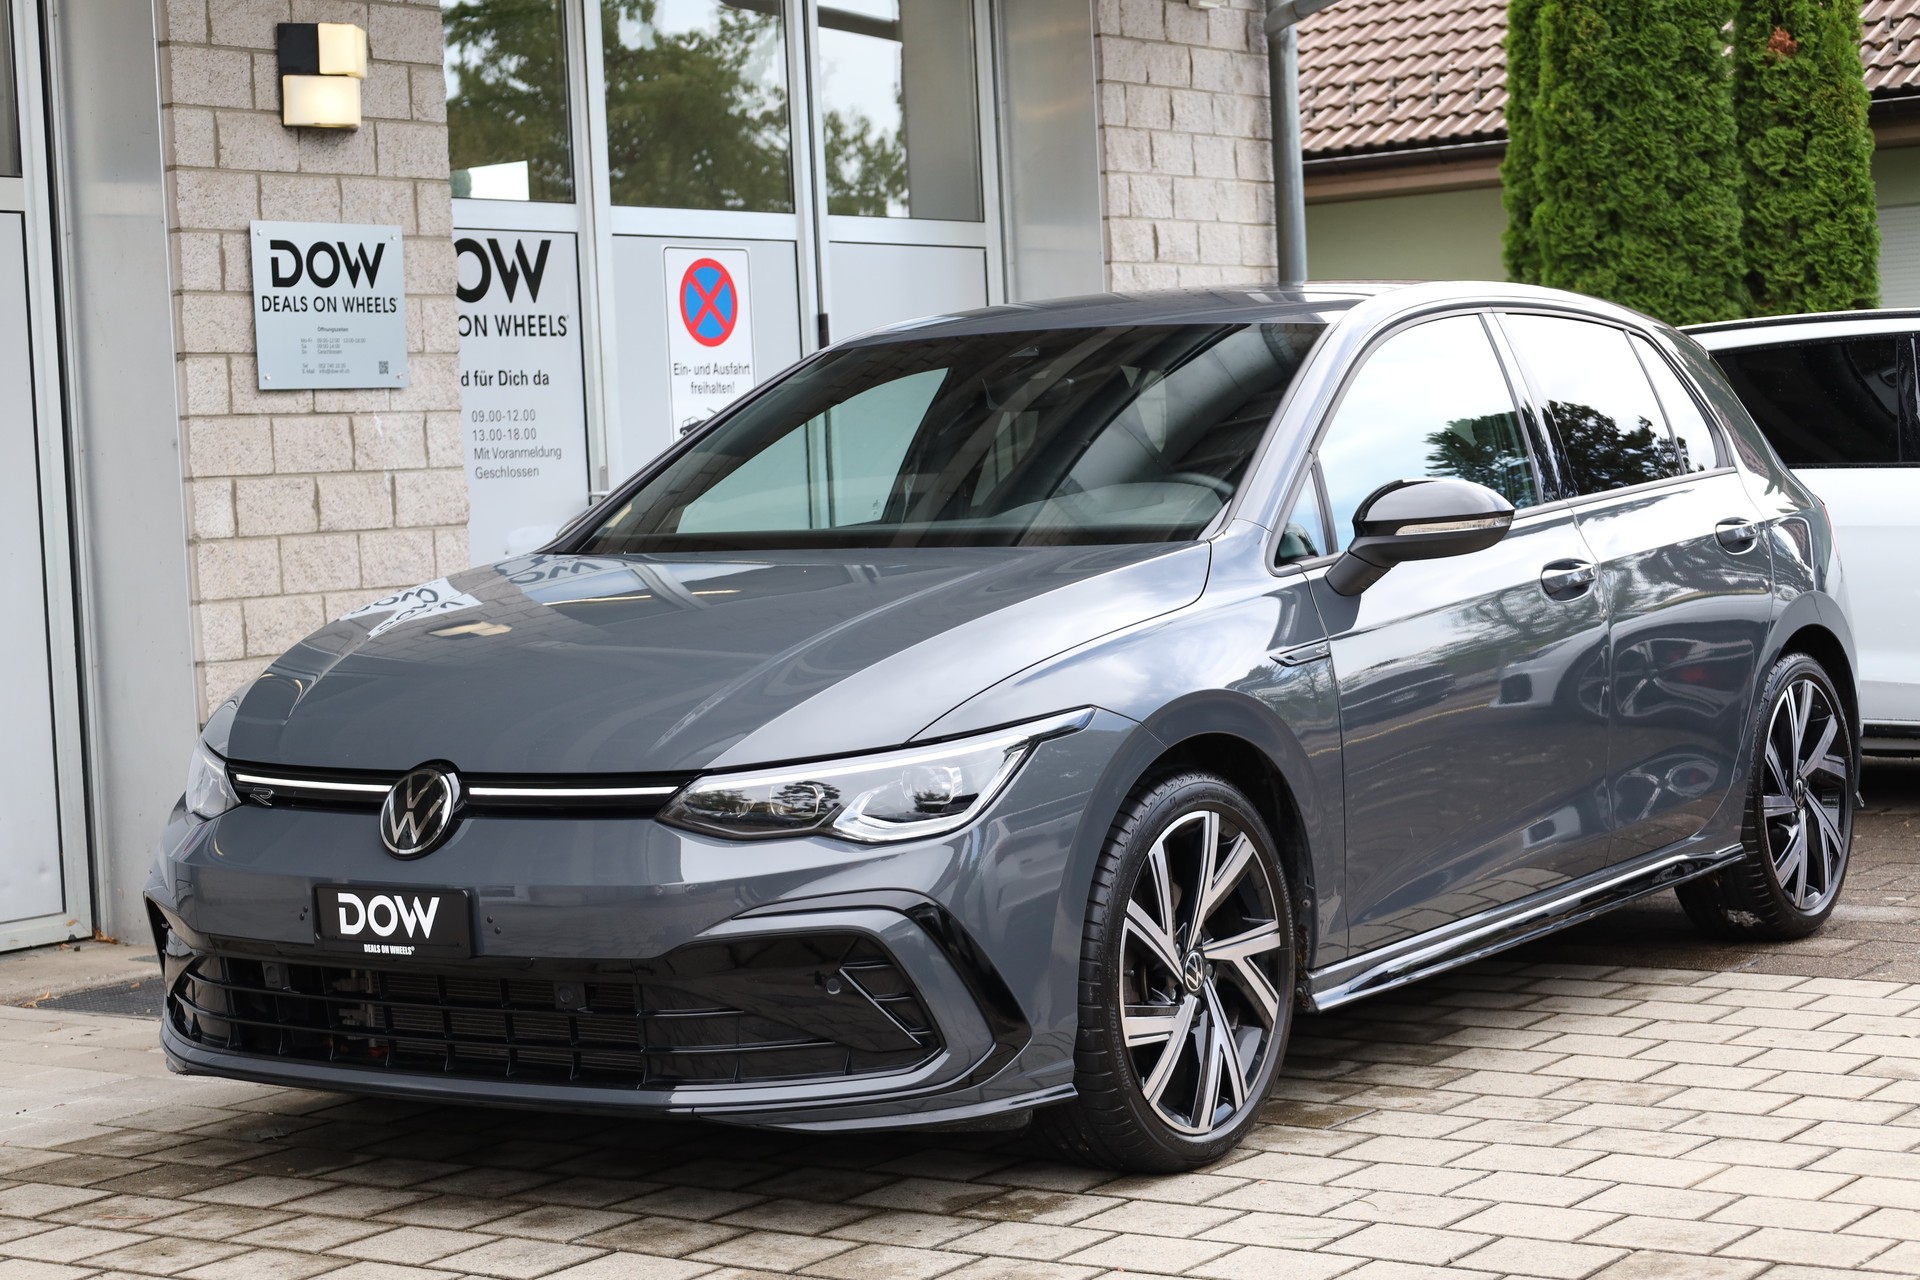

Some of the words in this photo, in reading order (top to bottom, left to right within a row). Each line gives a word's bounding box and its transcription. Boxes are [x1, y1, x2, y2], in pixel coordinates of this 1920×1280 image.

[270, 239, 386, 289] DOW
[261, 295, 308, 313] DEALS
[313, 296, 337, 313] ON
[458, 314, 487, 337] ON
[673, 362, 692, 376] Ein-
[694, 363, 711, 376] und
[713, 362, 751, 376] Ausfahrt
[474, 370, 493, 387] für
[498, 370, 528, 386] Dich
[533, 369, 550, 385] da
[690, 381, 735, 394] freihalten!
[471, 409, 536, 422] 09.00-12.00
[472, 428, 537, 441] 13.00-18.00
[474, 447, 490, 460] Mit
[491, 446, 562, 460] Voranmeldung
[475, 466, 540, 479] Geschlossen
[337, 892, 440, 939] DOW
[363, 943, 381, 954] DEALS
[381, 944, 390, 954] ON
